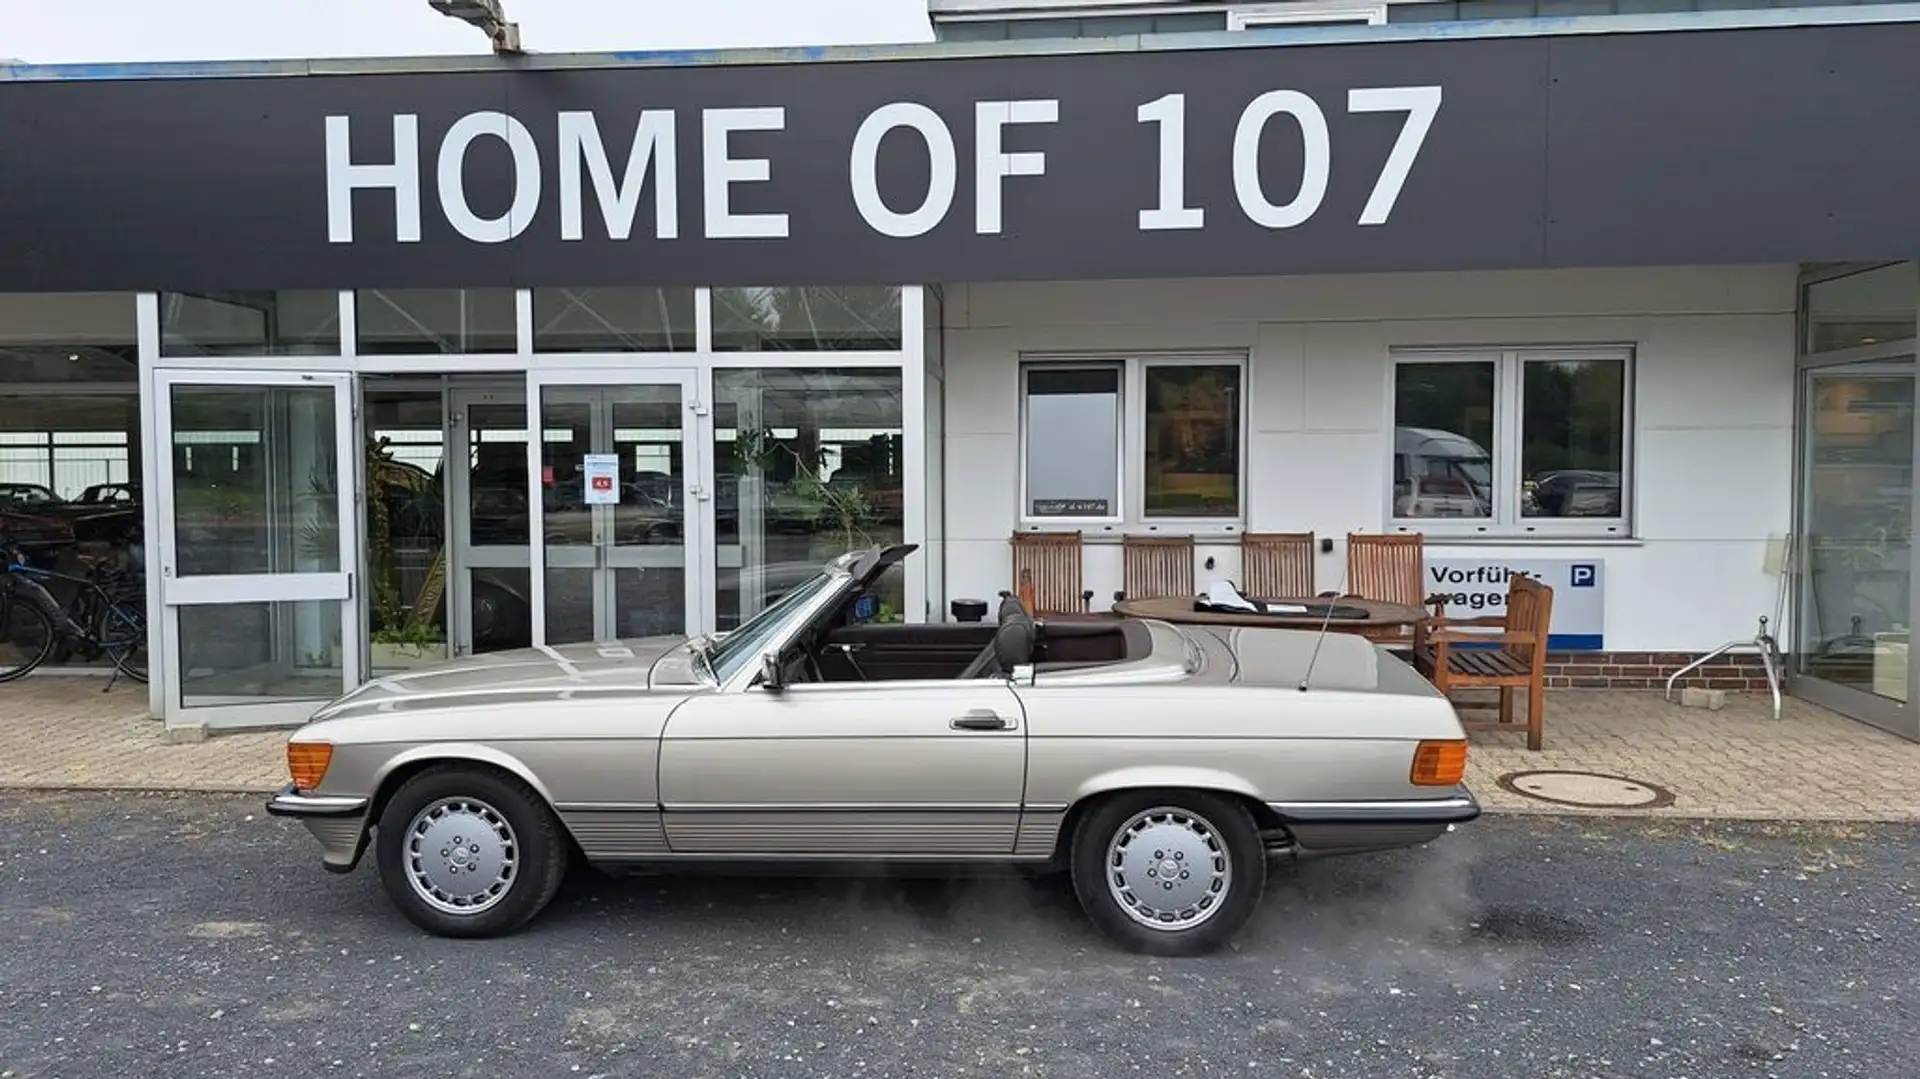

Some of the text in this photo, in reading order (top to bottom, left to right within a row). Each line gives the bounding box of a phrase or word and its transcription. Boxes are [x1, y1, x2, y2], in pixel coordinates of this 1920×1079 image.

[326, 86, 1441, 242] HOME OF 107
[1575, 568, 1591, 584] P
[1430, 593, 1509, 609] age
